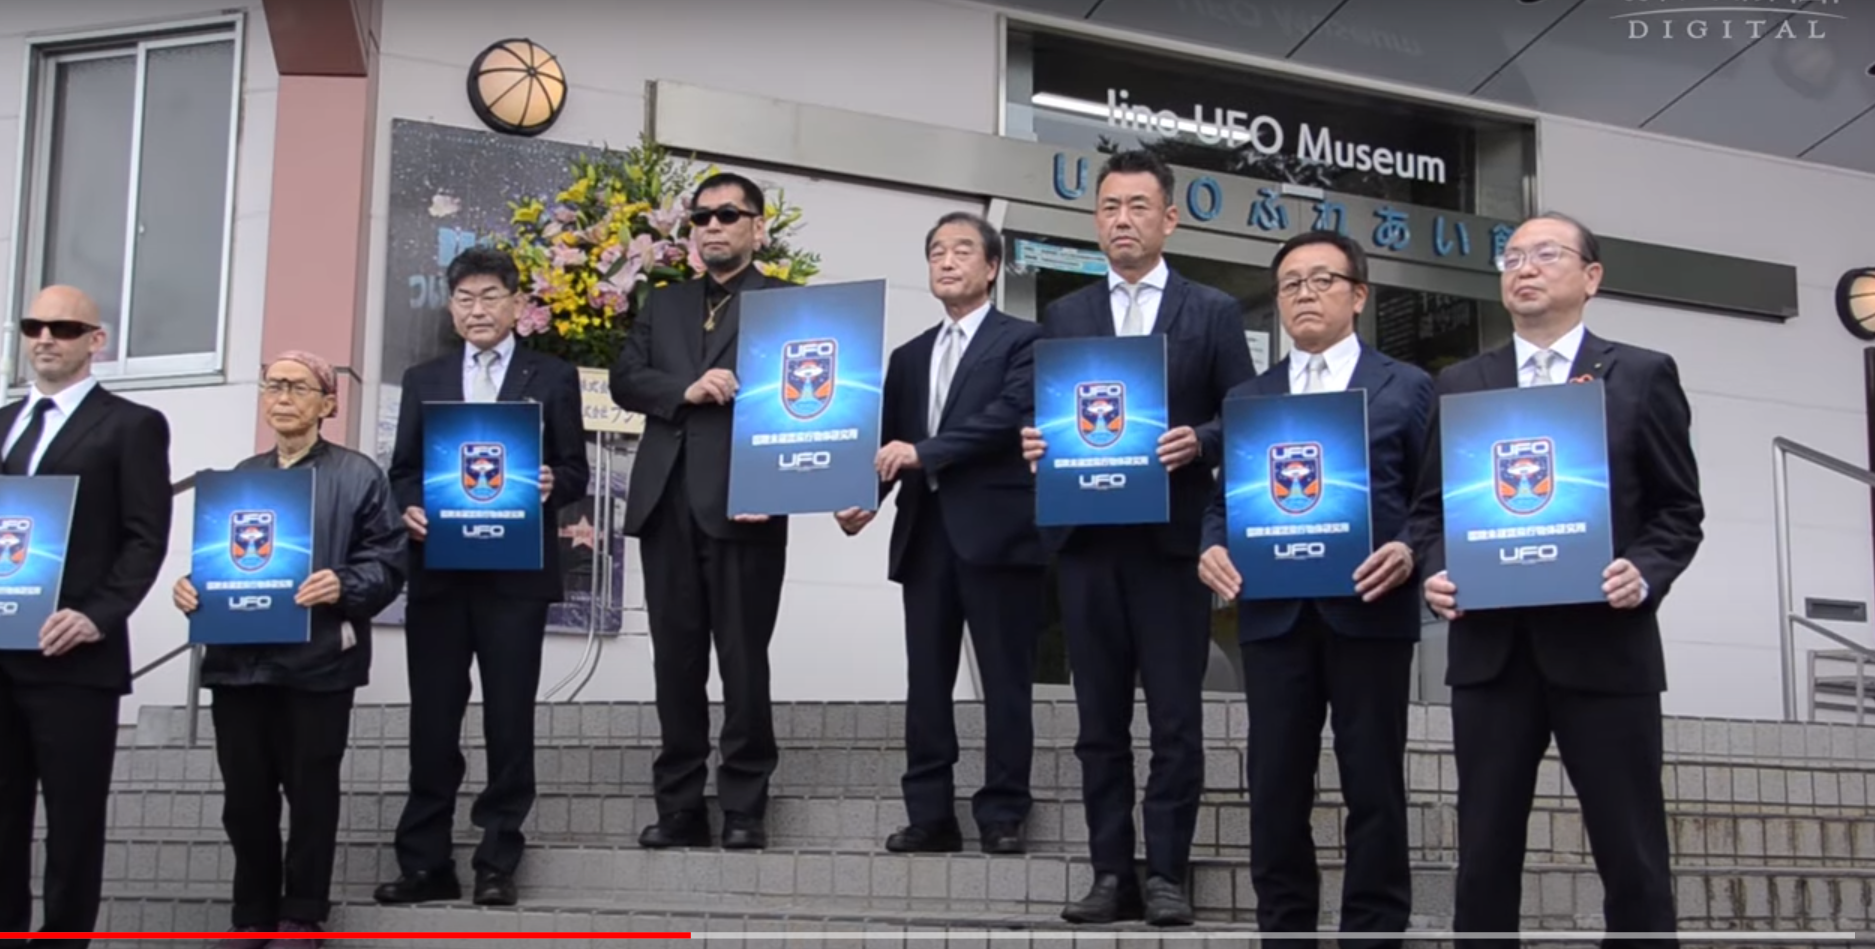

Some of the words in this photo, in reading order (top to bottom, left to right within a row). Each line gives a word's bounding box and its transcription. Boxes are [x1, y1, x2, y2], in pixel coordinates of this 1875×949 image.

[1194, 104, 1284, 155] UFO
[1297, 123, 1446, 184] Museum
[786, 342, 834, 359] UFO
[1079, 384, 1122, 397] UFO
[463, 445, 503, 457] UFO
[1272, 446, 1320, 460] UFO
[1497, 441, 1550, 457] UFO
[778, 451, 831, 469] UFO
[1079, 473, 1127, 488] UFO
[0, 519, 31, 531] FO
[233, 512, 273, 525] UFO
[462, 525, 505, 538] UFO
[1273, 542, 1326, 558] UFO
[1499, 544, 1558, 562] UFO
[228, 595, 272, 610] UFO
